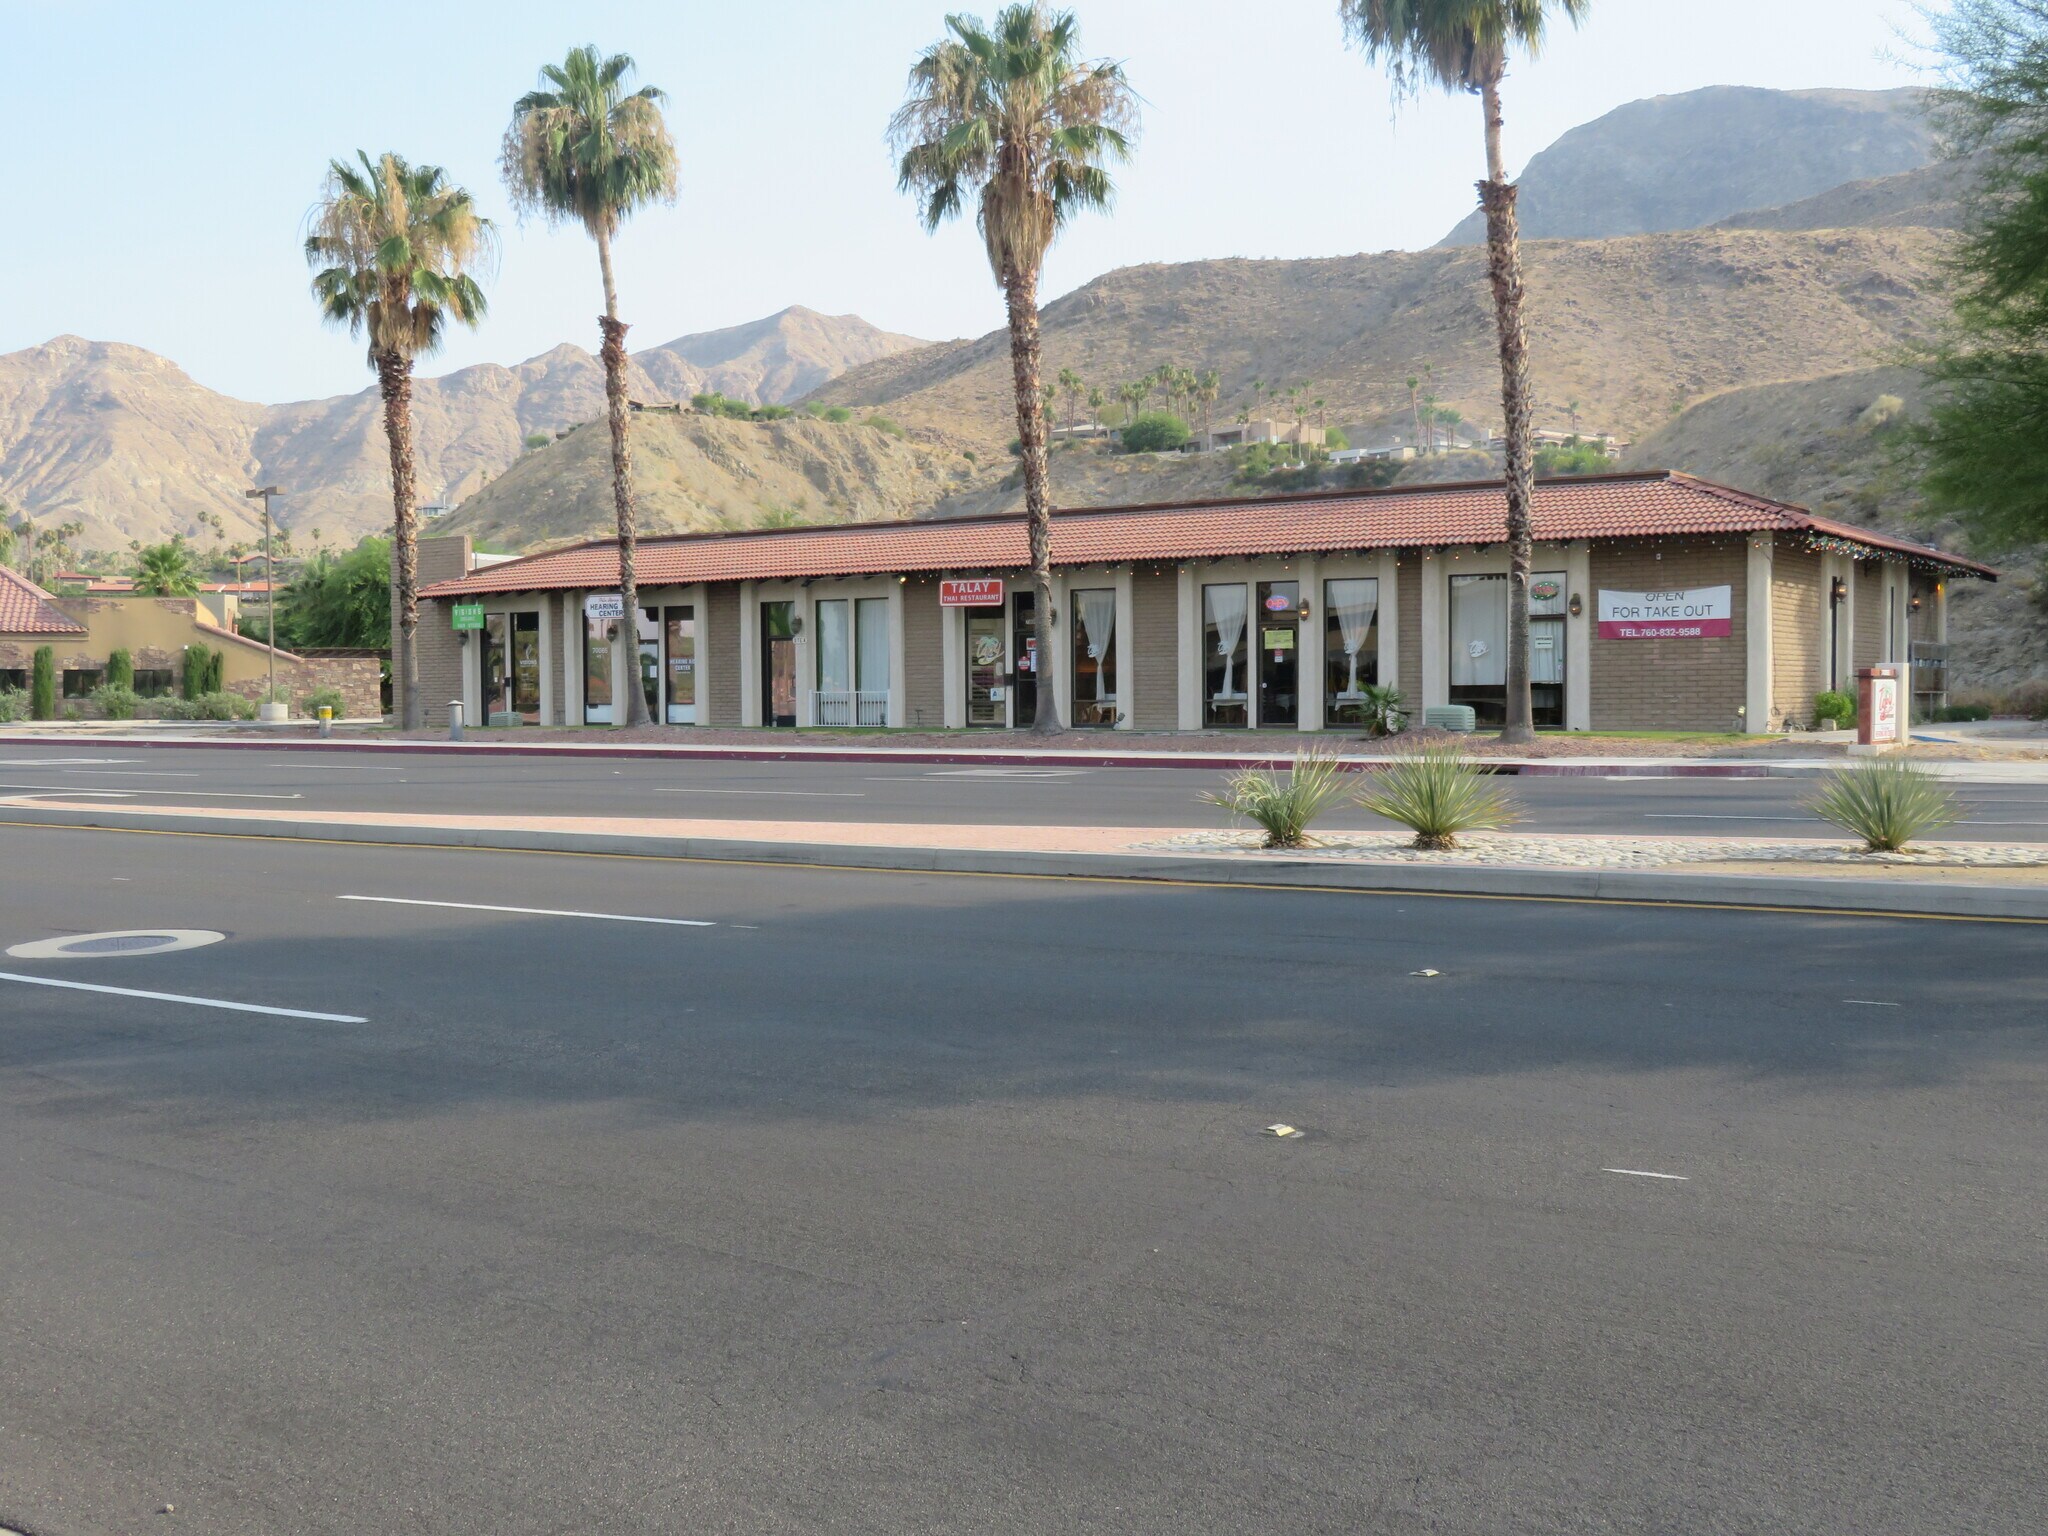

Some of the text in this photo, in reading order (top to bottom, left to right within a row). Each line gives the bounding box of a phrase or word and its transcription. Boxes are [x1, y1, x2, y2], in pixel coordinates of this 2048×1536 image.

[951, 582, 990, 593] TALAY
[960, 594, 999, 602] RESTAURANT
[1645, 592, 1684, 602] OPEN
[1612, 605, 1714, 618] FOR TAKE OUT
